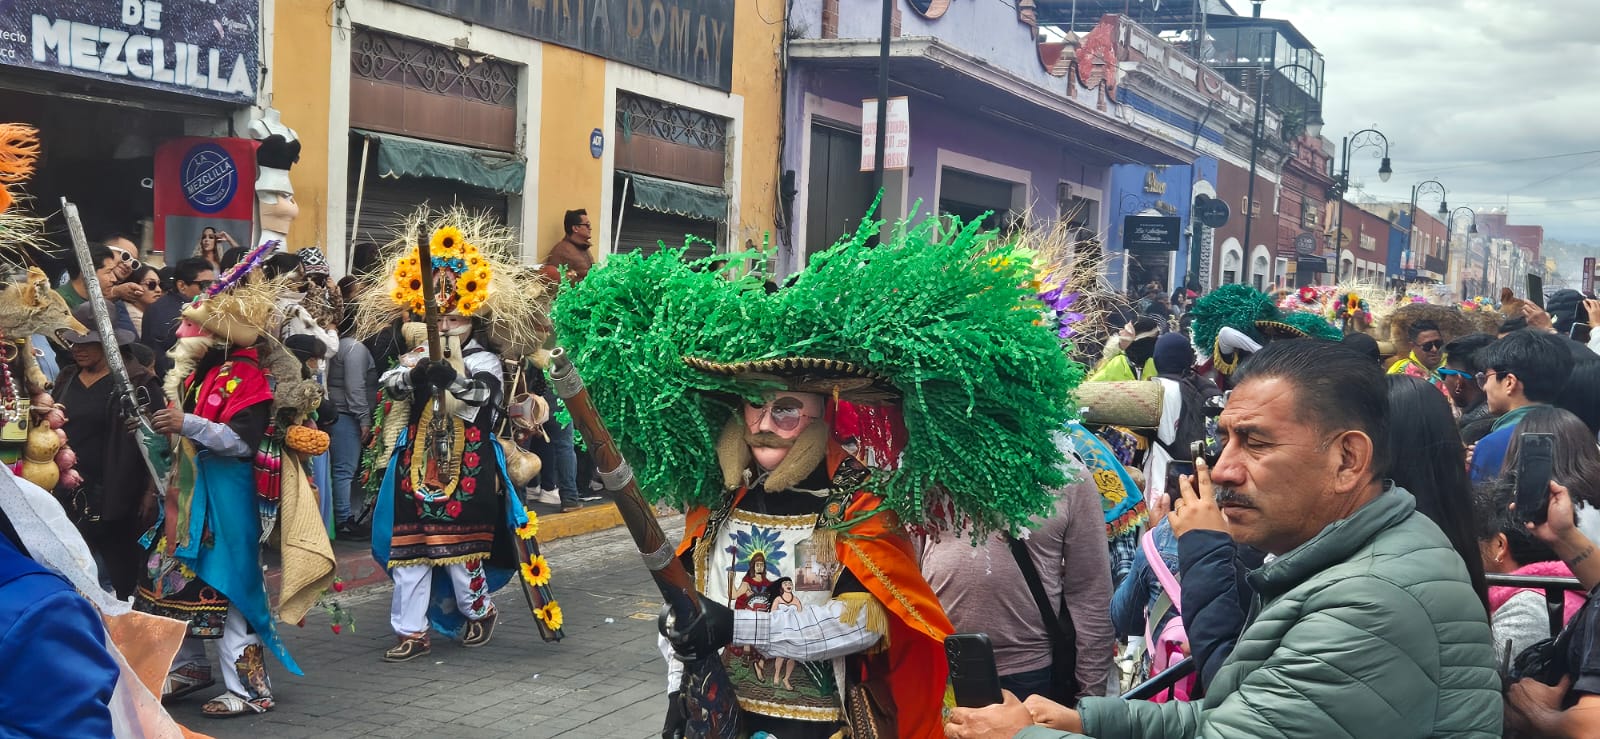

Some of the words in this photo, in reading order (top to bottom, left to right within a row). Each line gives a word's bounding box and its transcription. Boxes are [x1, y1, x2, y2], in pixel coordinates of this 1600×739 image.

[122, 0, 163, 31] DE
[627, 0, 726, 64] DOMAY
[32, 13, 254, 97] MEZCLILLA
[194, 154, 207, 165] LA
[187, 161, 232, 194] MEZCLILLA
